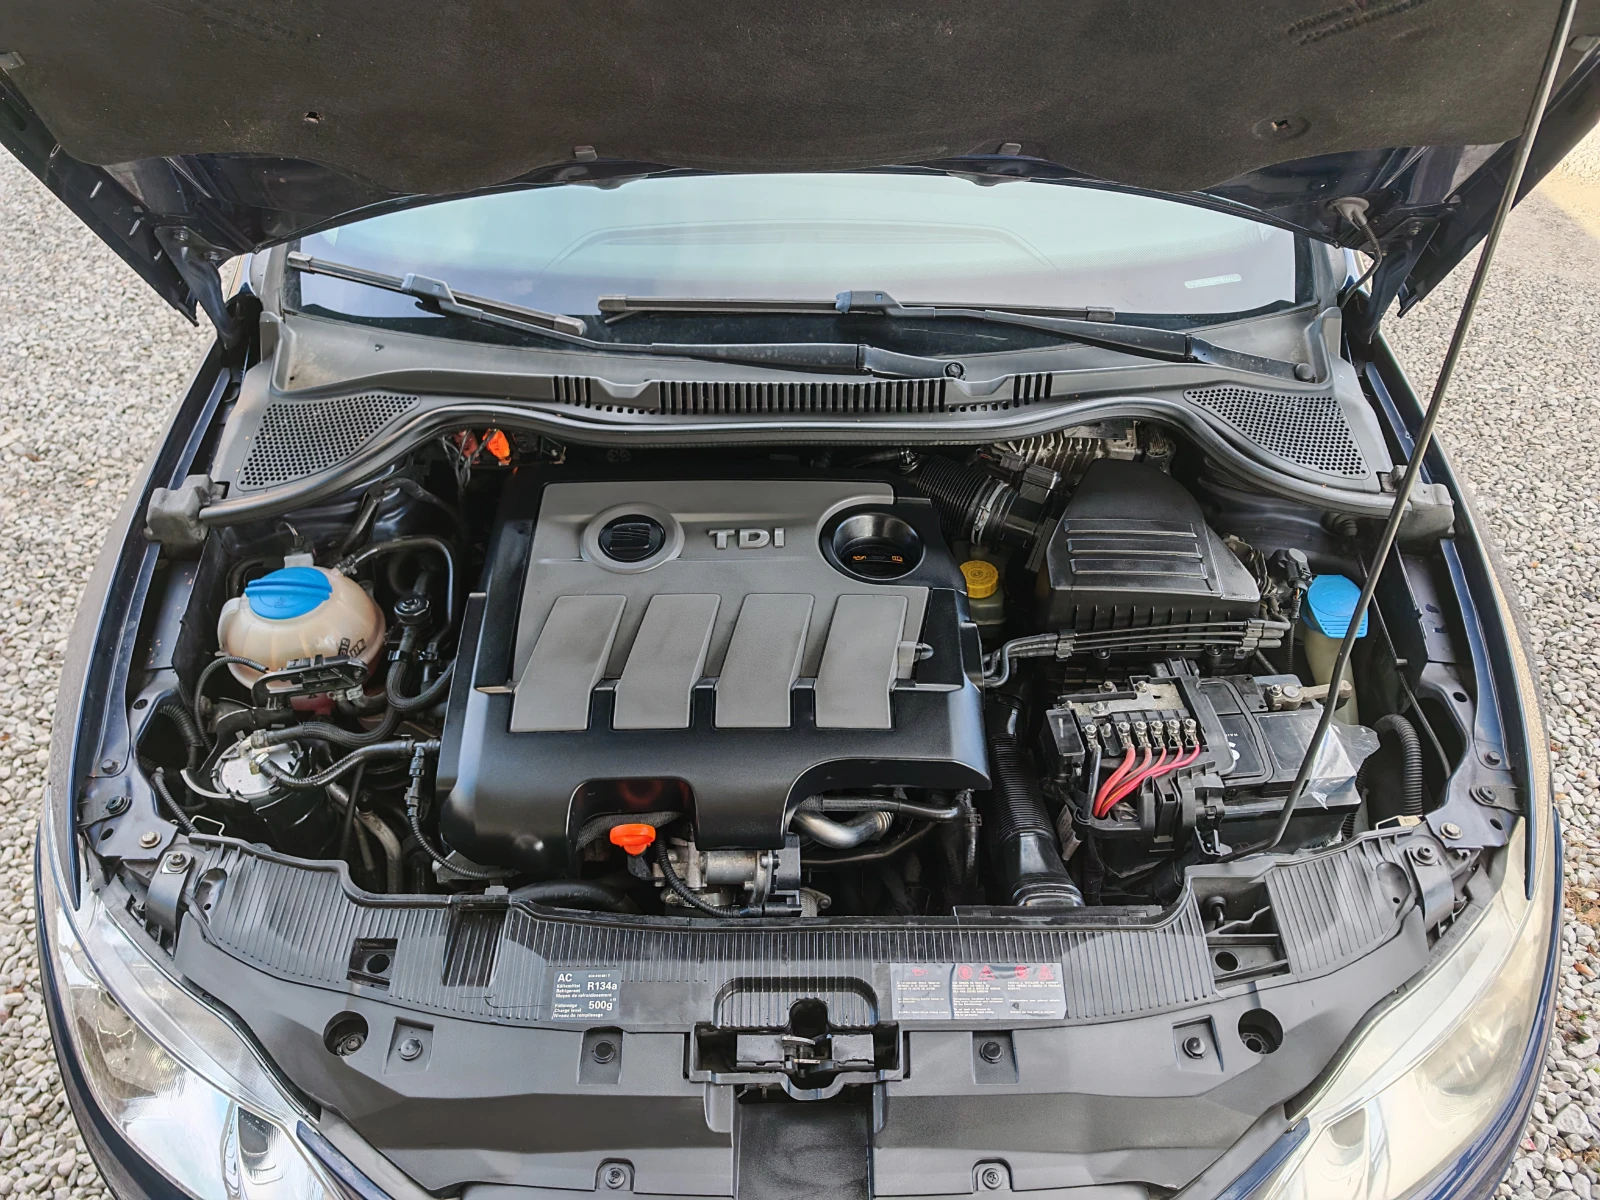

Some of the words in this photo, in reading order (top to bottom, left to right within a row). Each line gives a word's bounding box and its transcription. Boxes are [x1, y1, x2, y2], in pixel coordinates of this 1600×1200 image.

[707, 527, 786, 550] TDI
[557, 973, 573, 982] AC
[587, 981, 618, 991] R134a
[588, 1000, 613, 1011] 500g
